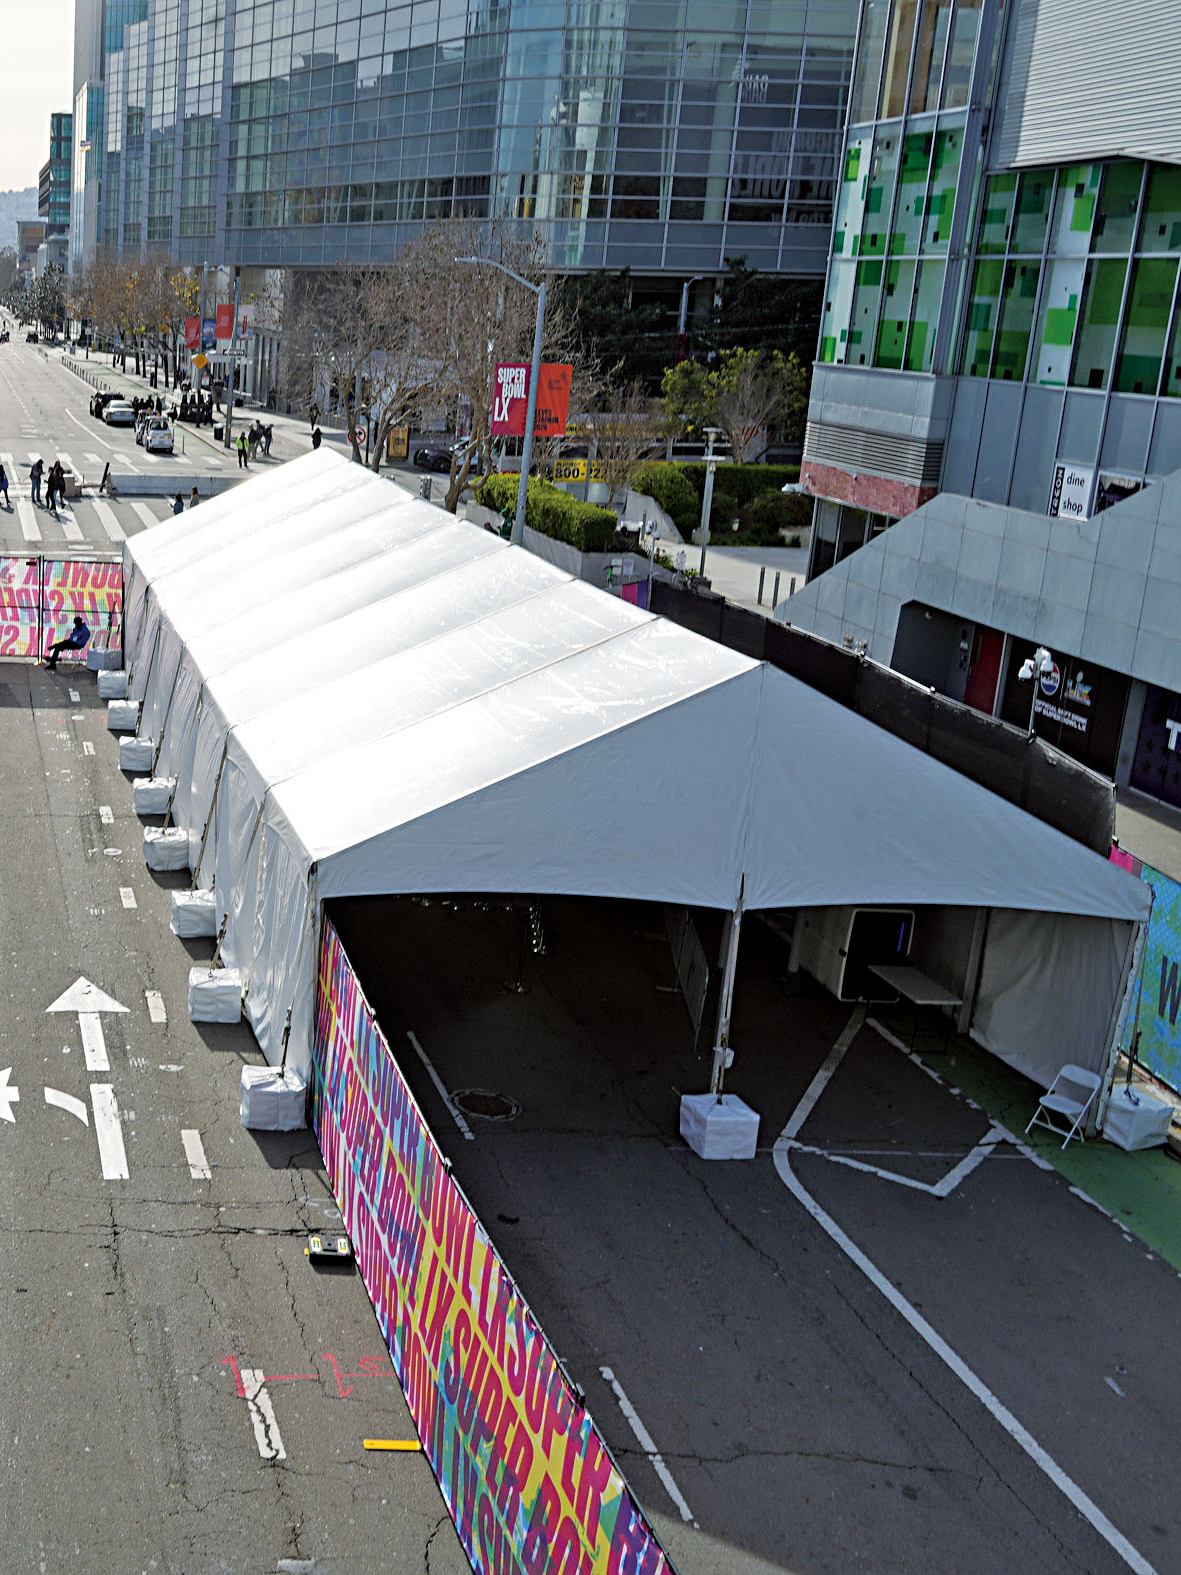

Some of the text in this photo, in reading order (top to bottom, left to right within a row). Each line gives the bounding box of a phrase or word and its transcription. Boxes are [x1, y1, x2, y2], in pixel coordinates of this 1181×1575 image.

[497, 367, 526, 384] SUPER
[502, 382, 527, 399] BOWL
[494, 397, 511, 422] LX
[1066, 472, 1085, 488] dine
[1062, 497, 1083, 516] shop
